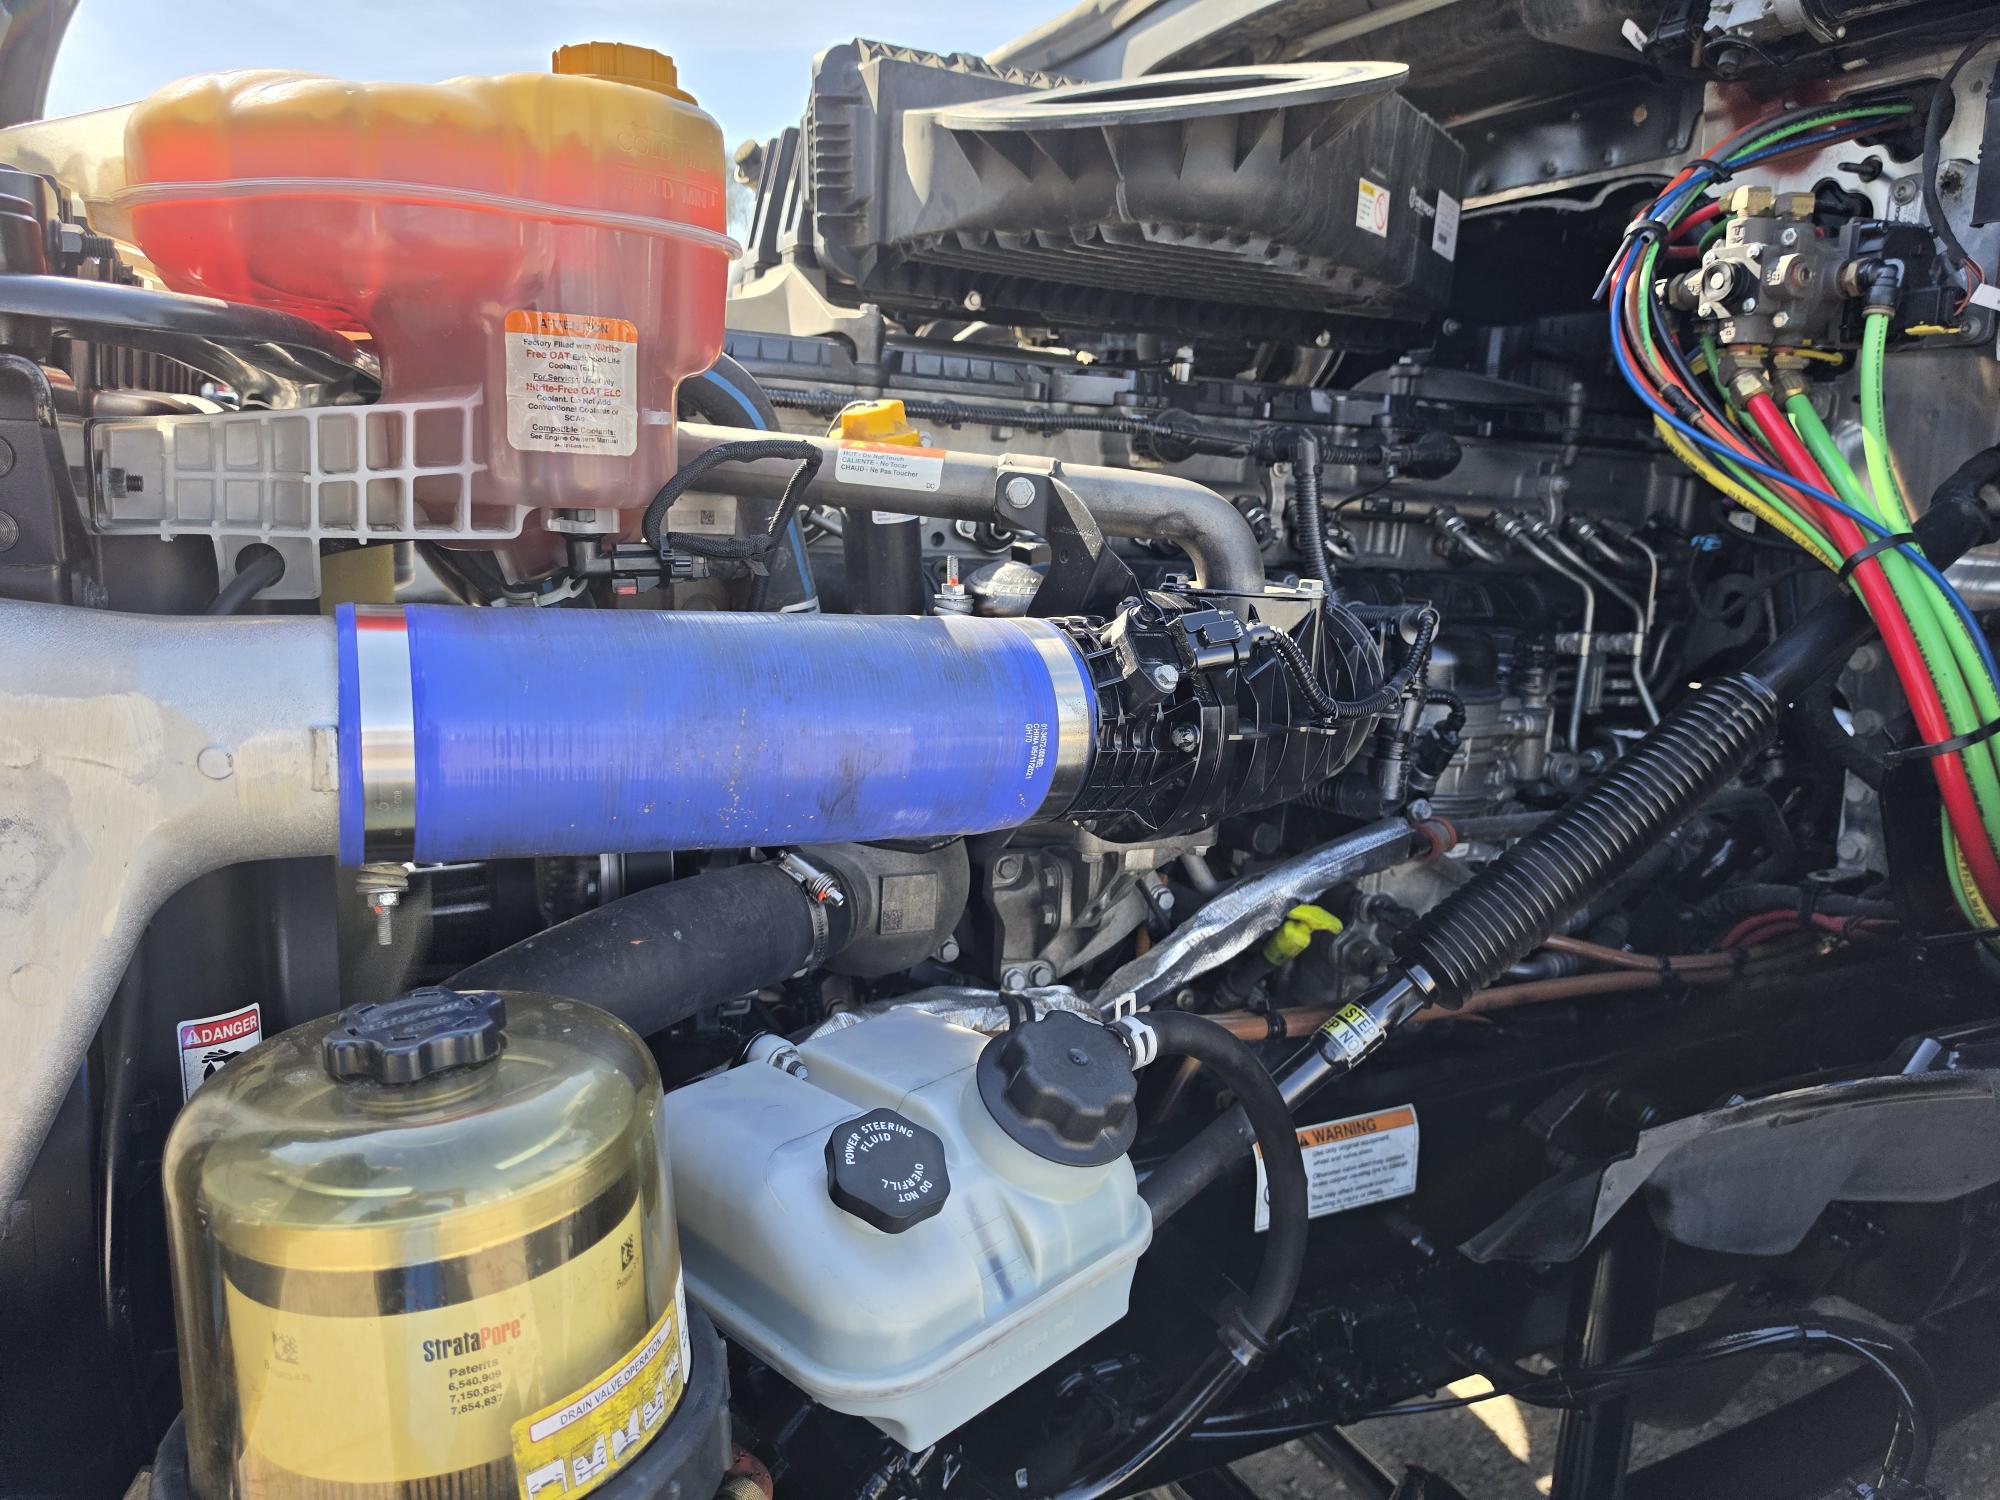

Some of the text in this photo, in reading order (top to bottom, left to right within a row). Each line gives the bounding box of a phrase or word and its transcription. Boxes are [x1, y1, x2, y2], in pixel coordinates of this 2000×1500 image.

[523, 338, 552, 349] Factory
[554, 340, 574, 348] Filled
[576, 342, 592, 350] with
[526, 349, 547, 358] Free
[550, 350, 570, 360] OAT
[608, 356, 620, 364] Life
[548, 362, 578, 371] Coolant
[526, 382, 621, 398] Nitrite-Free OAT ELC
[528, 402, 576, 412] Conventional
[532, 424, 578, 434] Compatible
[842, 456, 874, 465] CALIENTE
[840, 464, 864, 472] CHAUD
[894, 470, 918, 478] Toucher
[202, 1016, 257, 1043] DANGER
[1345, 1008, 1376, 1036] STEP
[1339, 1030, 1360, 1052] NO
[1312, 1118, 1376, 1144] WARNING
[845, 1122, 914, 1165] POWER STEERING
[860, 1132, 892, 1152] FLUID
[881, 1163, 924, 1191] OVERFILL
[898, 1180, 933, 1203] DO NOT
[422, 1318, 521, 1362] StrataPore
[449, 1358, 499, 1378] Patents
[448, 1370, 502, 1391] 6,540,909
[560, 1401, 593, 1426] DRAIN
[594, 1378, 623, 1403] VALVE
[624, 1334, 663, 1382] OPERATION
